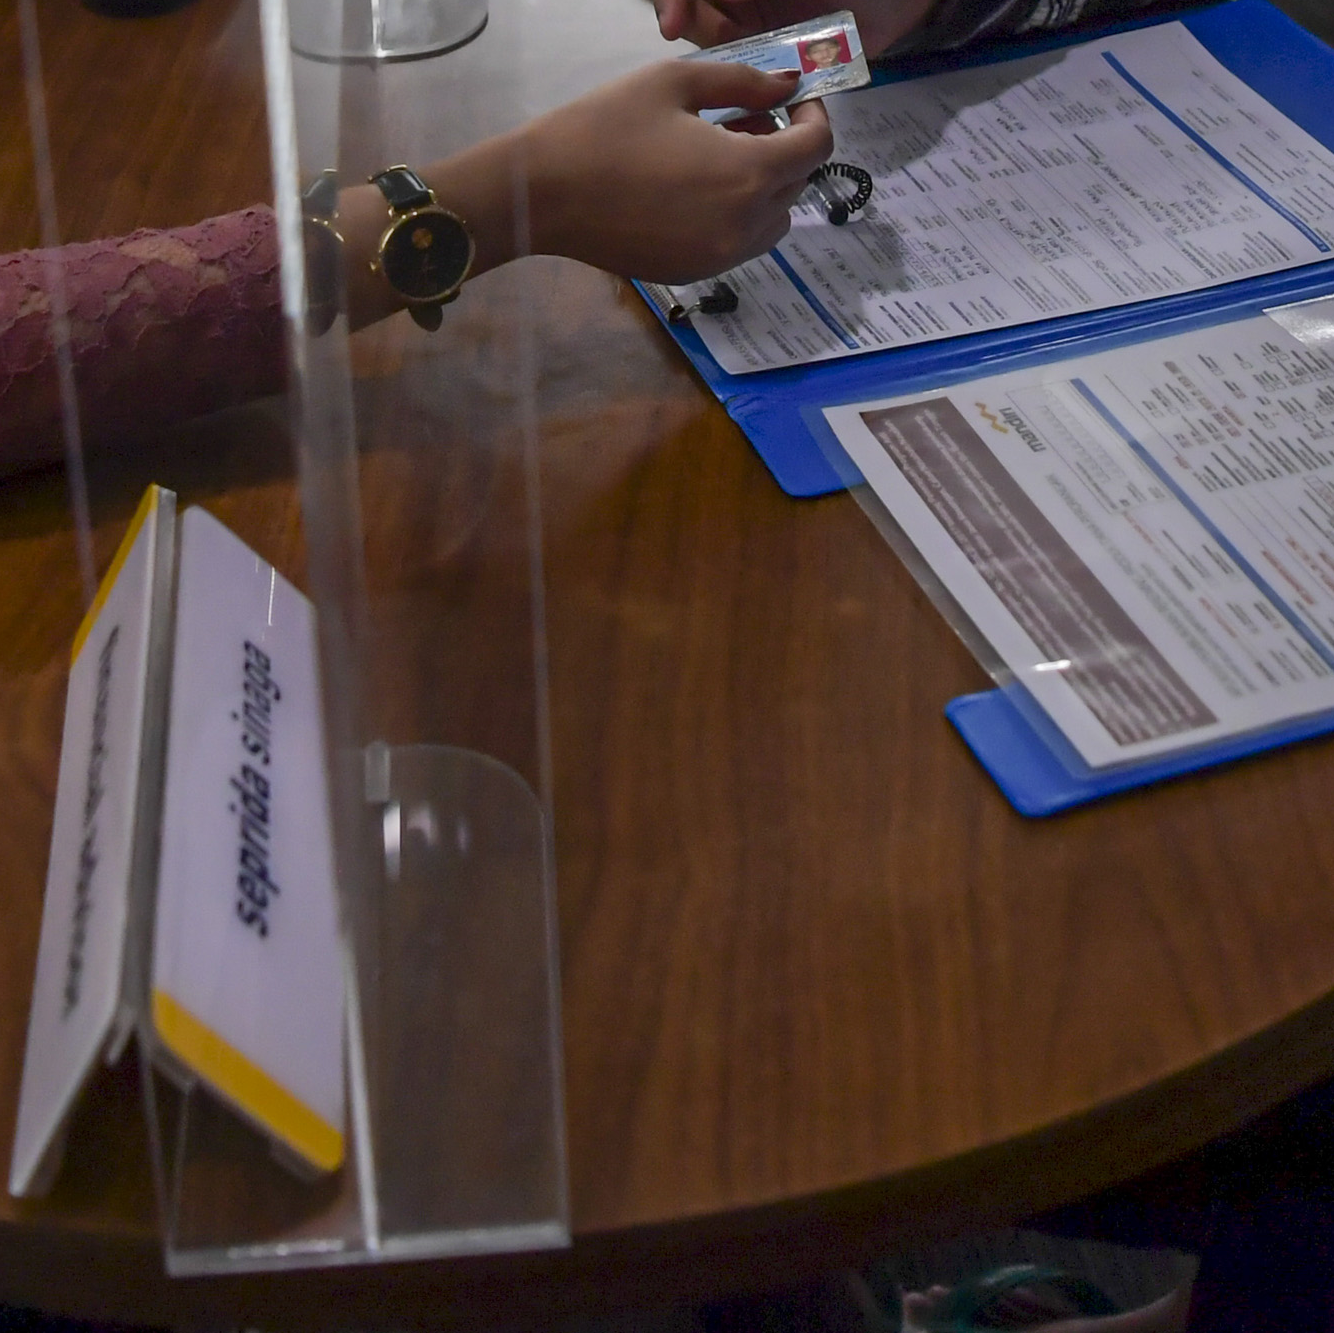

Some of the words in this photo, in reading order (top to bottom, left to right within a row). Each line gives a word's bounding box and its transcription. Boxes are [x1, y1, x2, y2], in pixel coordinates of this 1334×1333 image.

[999, 407, 1046, 453] mandiri
[231, 640, 281, 764] sinaga
[228, 765, 281, 939] seprida
